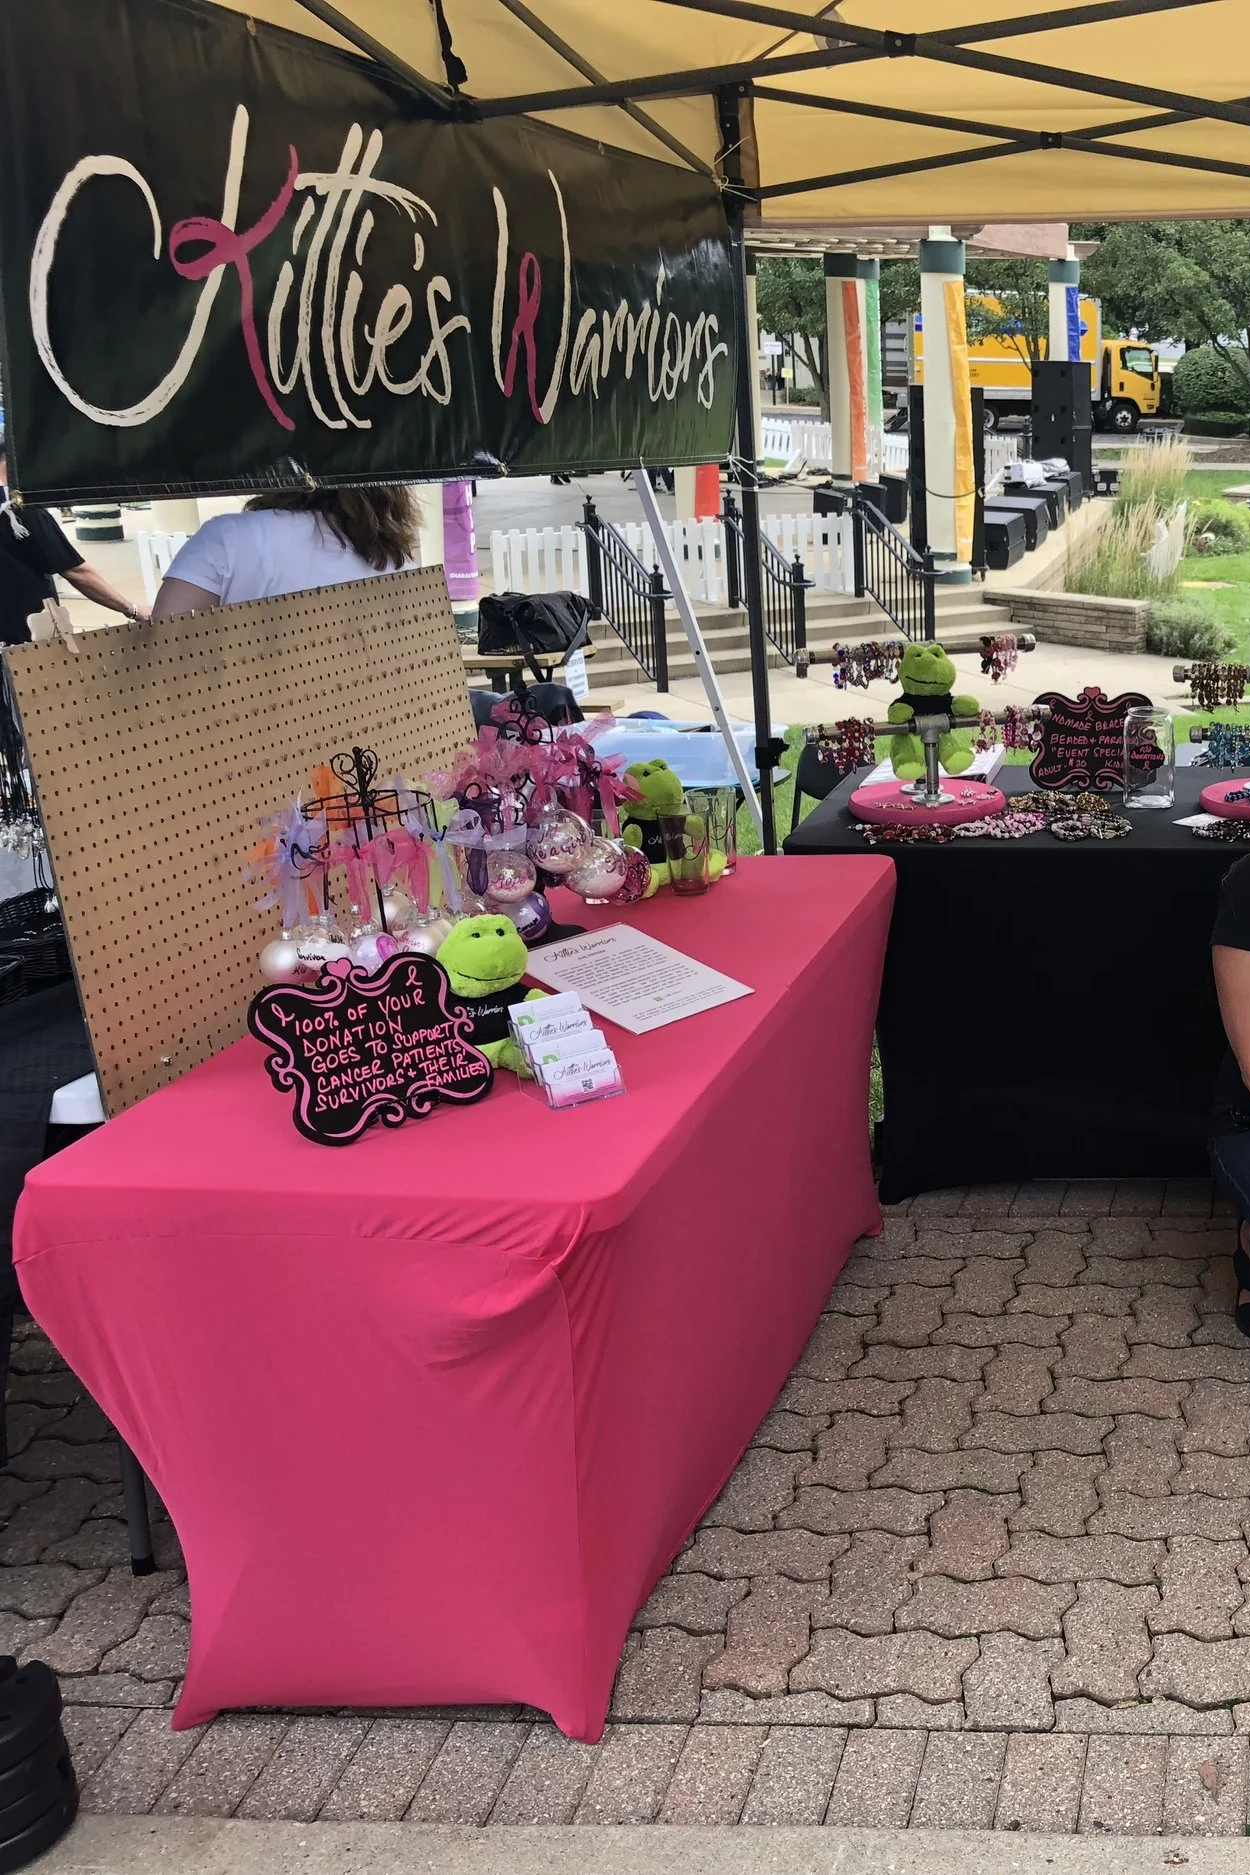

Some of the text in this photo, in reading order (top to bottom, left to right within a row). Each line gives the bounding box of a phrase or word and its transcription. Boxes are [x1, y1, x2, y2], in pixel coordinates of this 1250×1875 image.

[492, 169, 730, 426] Warriors
[1050, 733, 1088, 745] BEADED
[1052, 713, 1092, 731] NDMADE
[295, 989, 425, 1036] 100% OF YOUR
[302, 1015, 403, 1058] DONATION
[311, 1021, 454, 1074] GOES TO SUPPORT
[315, 1068, 405, 1113] SURVIVORS
[418, 1054, 468, 1075] THEIR
[317, 1060, 385, 1093] CANCER
[425, 1061, 487, 1088] FAMILIES
